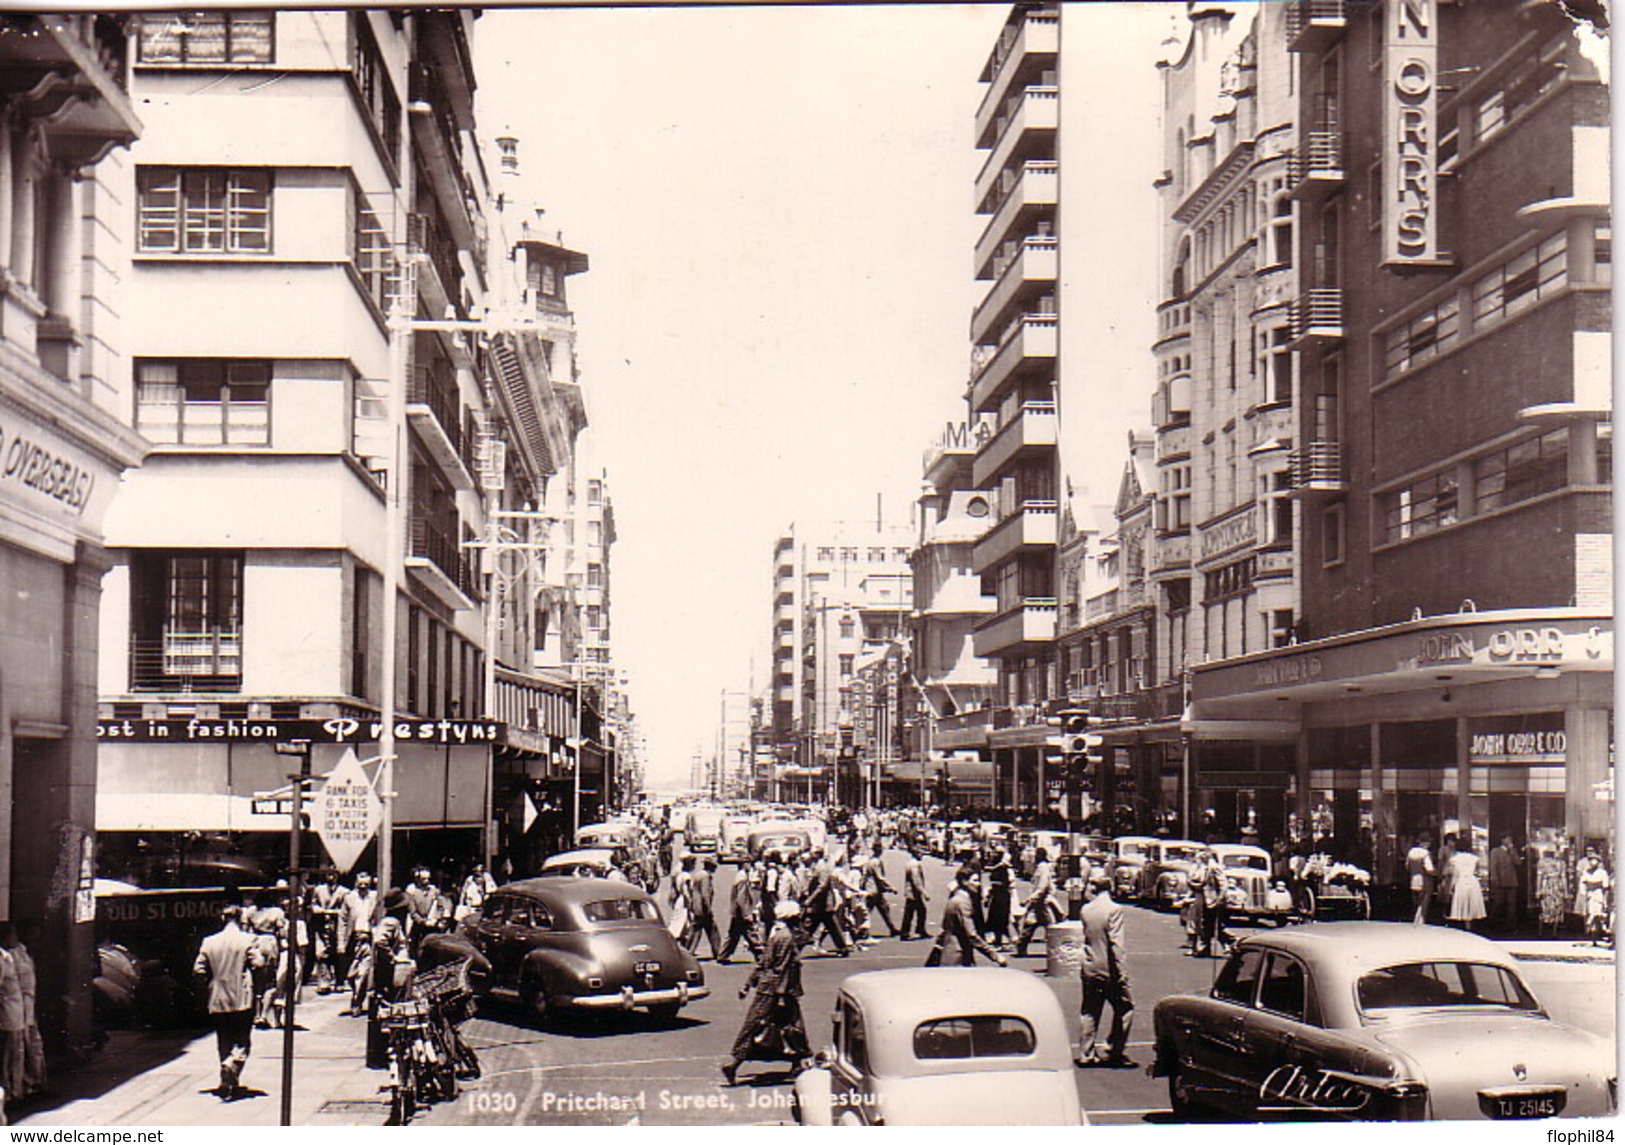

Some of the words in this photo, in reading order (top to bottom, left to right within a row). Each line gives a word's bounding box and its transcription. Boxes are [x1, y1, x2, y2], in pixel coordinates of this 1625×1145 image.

[1394, 57, 1431, 258] ORR'S
[1488, 627, 1564, 663] ORR
[148, 720, 169, 737] in
[187, 719, 278, 739] fashion
[326, 785, 348, 796] RANK
[352, 785, 368, 796] FOR
[339, 798, 368, 809] TAXIS
[339, 819, 368, 831] TAXIS
[1499, 1101, 1513, 1116] TJ
[1520, 1099, 1555, 1116] 25145
